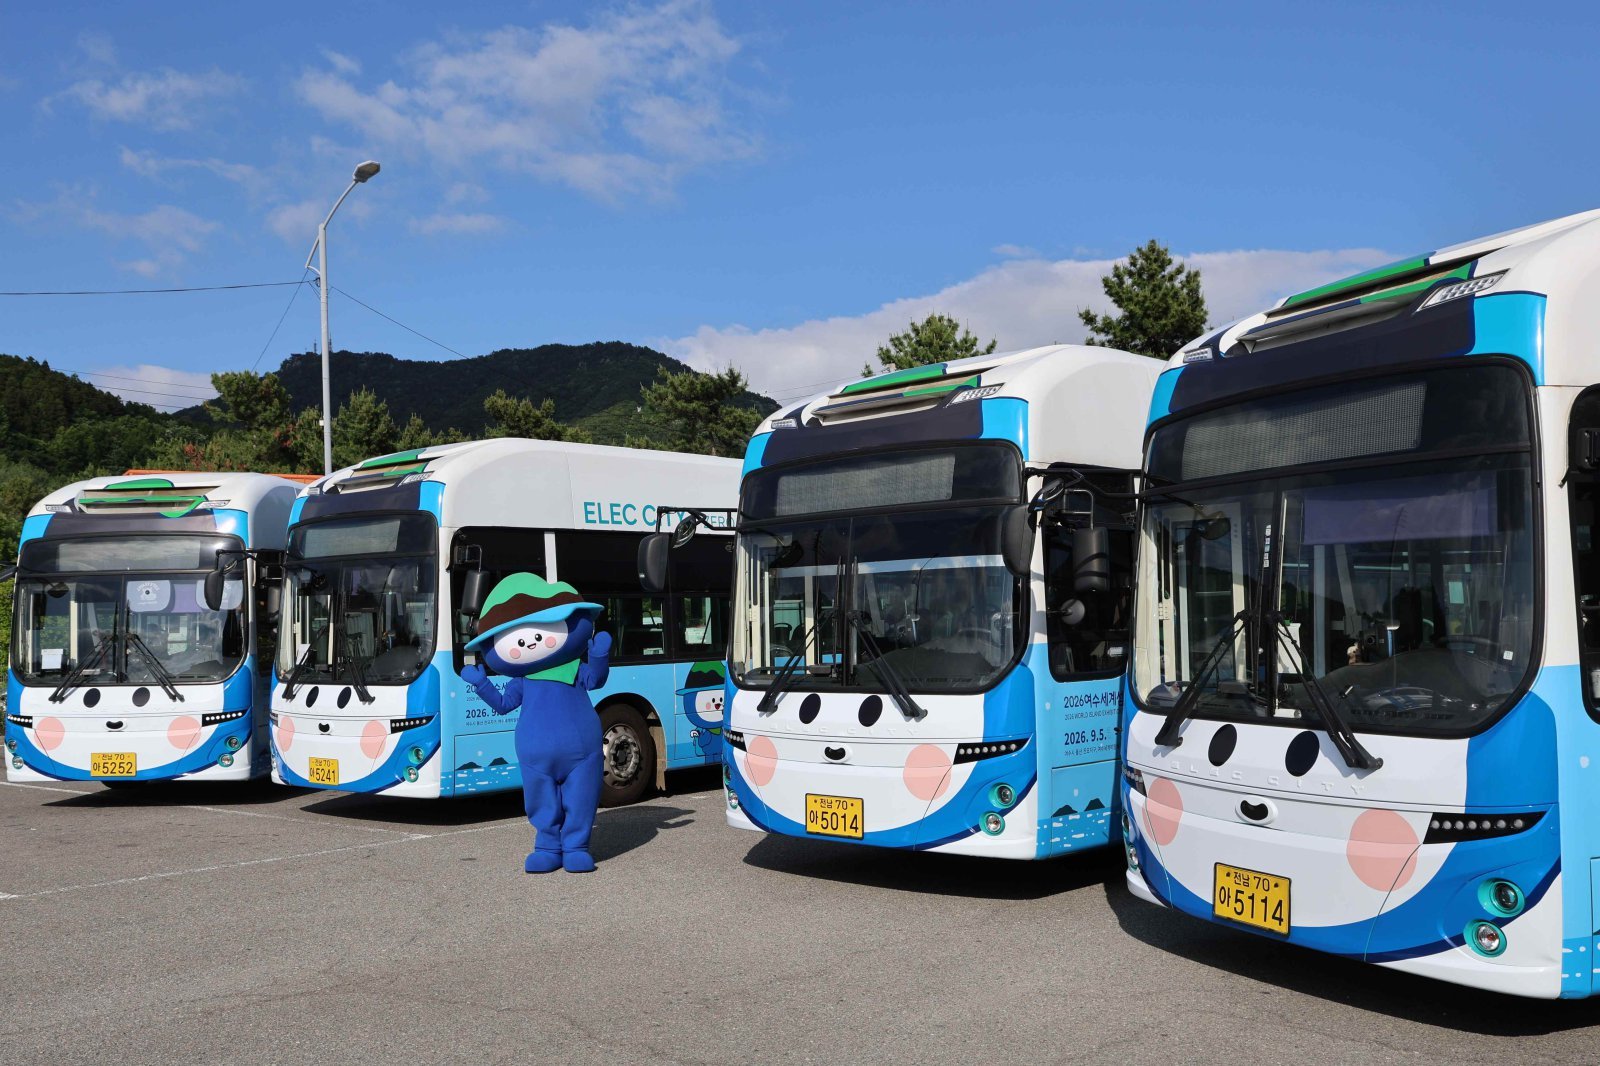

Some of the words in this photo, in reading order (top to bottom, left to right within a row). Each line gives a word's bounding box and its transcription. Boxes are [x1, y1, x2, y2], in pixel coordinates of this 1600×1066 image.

[584, 502, 637, 526] ELEC
[466, 708, 490, 718] 2026.
[1064, 730, 1088, 746] 2026.
[820, 798, 833, 809] 전남
[835, 799, 848, 811] 70
[1233, 871, 1250, 888] 전남
[1253, 875, 1270, 892] 70
